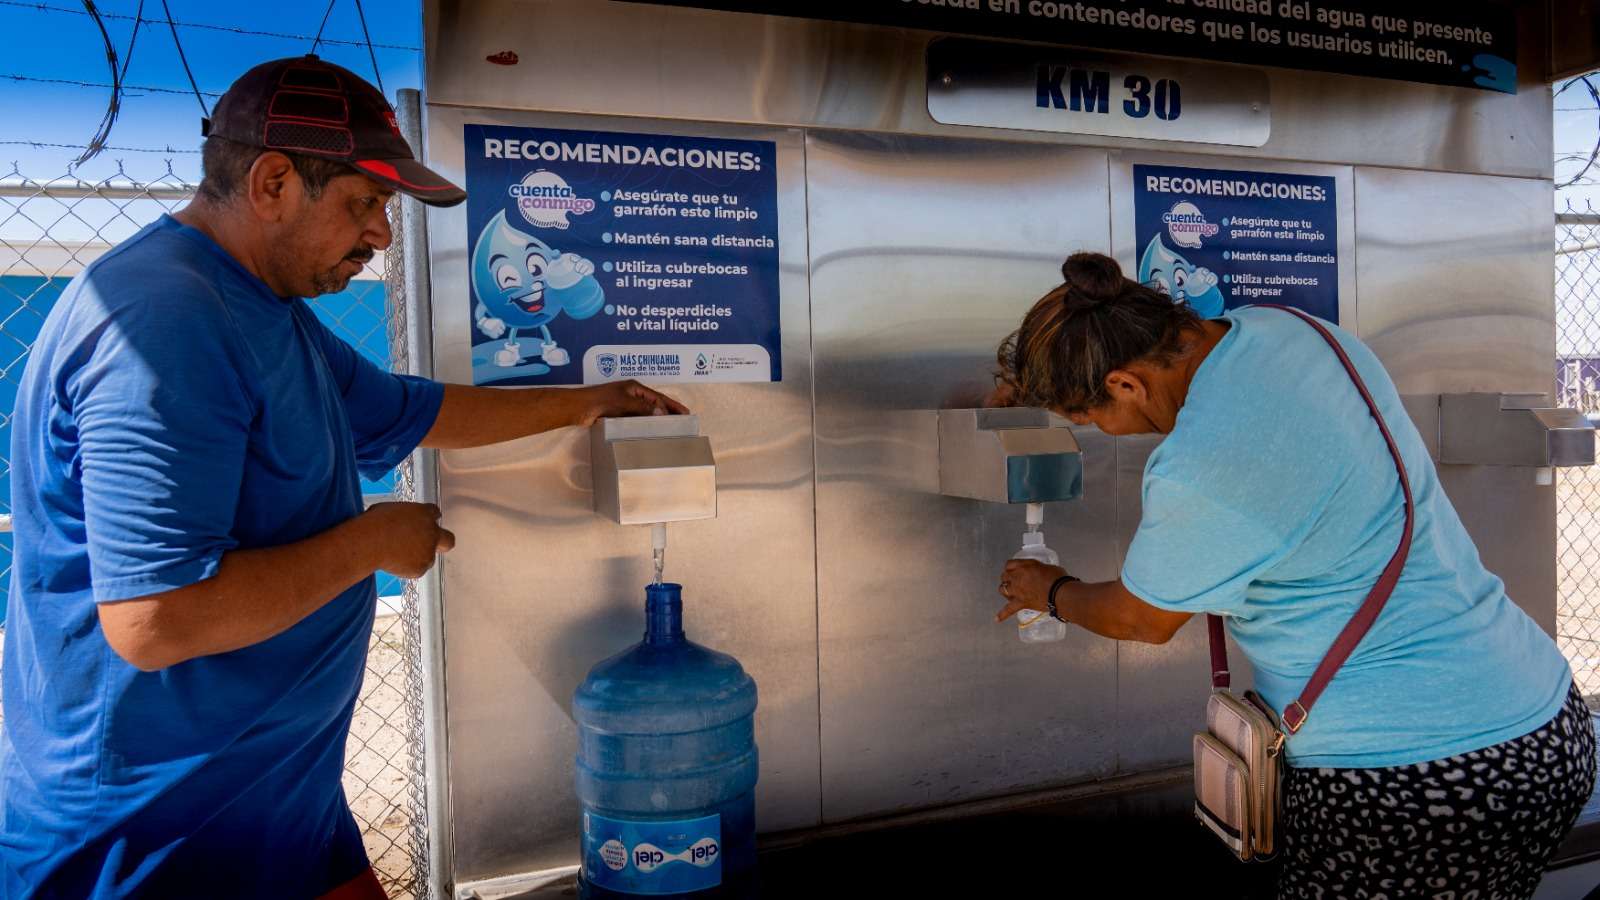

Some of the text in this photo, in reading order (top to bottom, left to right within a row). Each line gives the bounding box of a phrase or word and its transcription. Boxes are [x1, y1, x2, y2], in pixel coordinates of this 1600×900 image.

[1278, 1, 1311, 20] del
[1316, 8, 1366, 29] agua
[1371, 14, 1408, 34] que
[1413, 20, 1493, 45] presente
[988, 0, 1020, 14] en
[1028, 0, 1196, 35] contenedores
[1203, 21, 1245, 41] que
[1250, 22, 1281, 45] los
[1287, 31, 1373, 56] usuarios
[1378, 39, 1453, 65] utilicen.
[1036, 64, 1182, 121] KM 30
[484, 138, 761, 171] RECOMENDACIONES:
[509, 183, 573, 199] cuenta
[1146, 175, 1326, 201] RECOMENDACIONES:
[521, 197, 594, 214] conmigo
[614, 189, 738, 208] Asegúrate que tu
[614, 203, 758, 222] garrafón este limpio
[1163, 212, 1204, 224] cuenta
[1171, 223, 1218, 236] conmigo
[1230, 216, 1312, 230] Asegúrate que tu
[615, 232, 775, 249] Mantén sana distancia
[1231, 228, 1325, 243] garrafón este limpio
[1231, 251, 1335, 264] Mantén sana distancia
[615, 261, 748, 276] Utiliza cubrebocas
[616, 277, 693, 291] al ingresar
[1231, 274, 1318, 286] Utiliza cubrebocas
[1231, 286, 1282, 297] al ingresar
[617, 305, 732, 320] No desperdicies
[617, 319, 719, 334] el vital líquido
[620, 353, 680, 365] MÁS CHIHUAHUA
[635, 851, 664, 866] ciel
[690, 844, 718, 864] ciel
